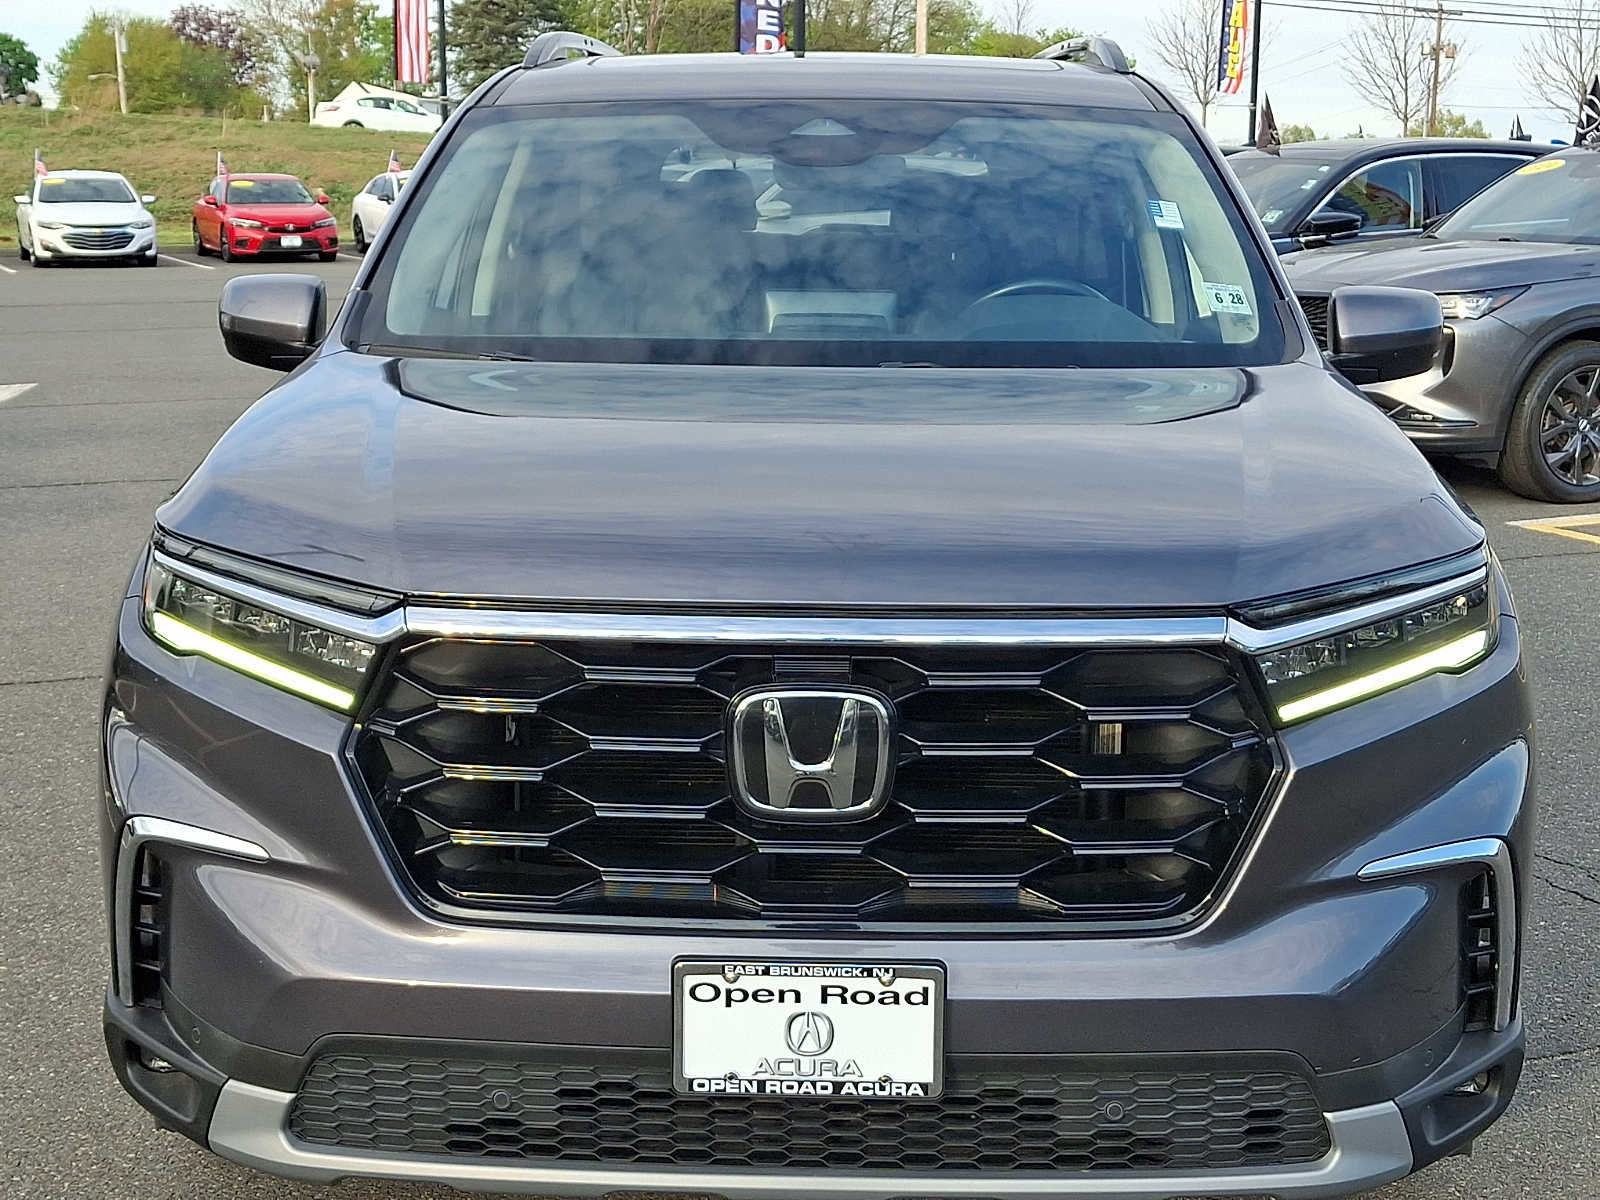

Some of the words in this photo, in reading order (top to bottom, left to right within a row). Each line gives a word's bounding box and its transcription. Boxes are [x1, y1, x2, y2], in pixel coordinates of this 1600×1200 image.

[1215, 292, 1224, 304] 6
[1229, 293, 1244, 305] 28
[724, 965, 766, 976] EAST
[688, 982, 802, 1008] Open
[820, 984, 929, 1006] Road
[752, 1057, 864, 1078] ACURA
[692, 1078, 758, 1094] OPEN
[765, 1080, 834, 1095] ROAD
[840, 1081, 925, 1097] ACURA
